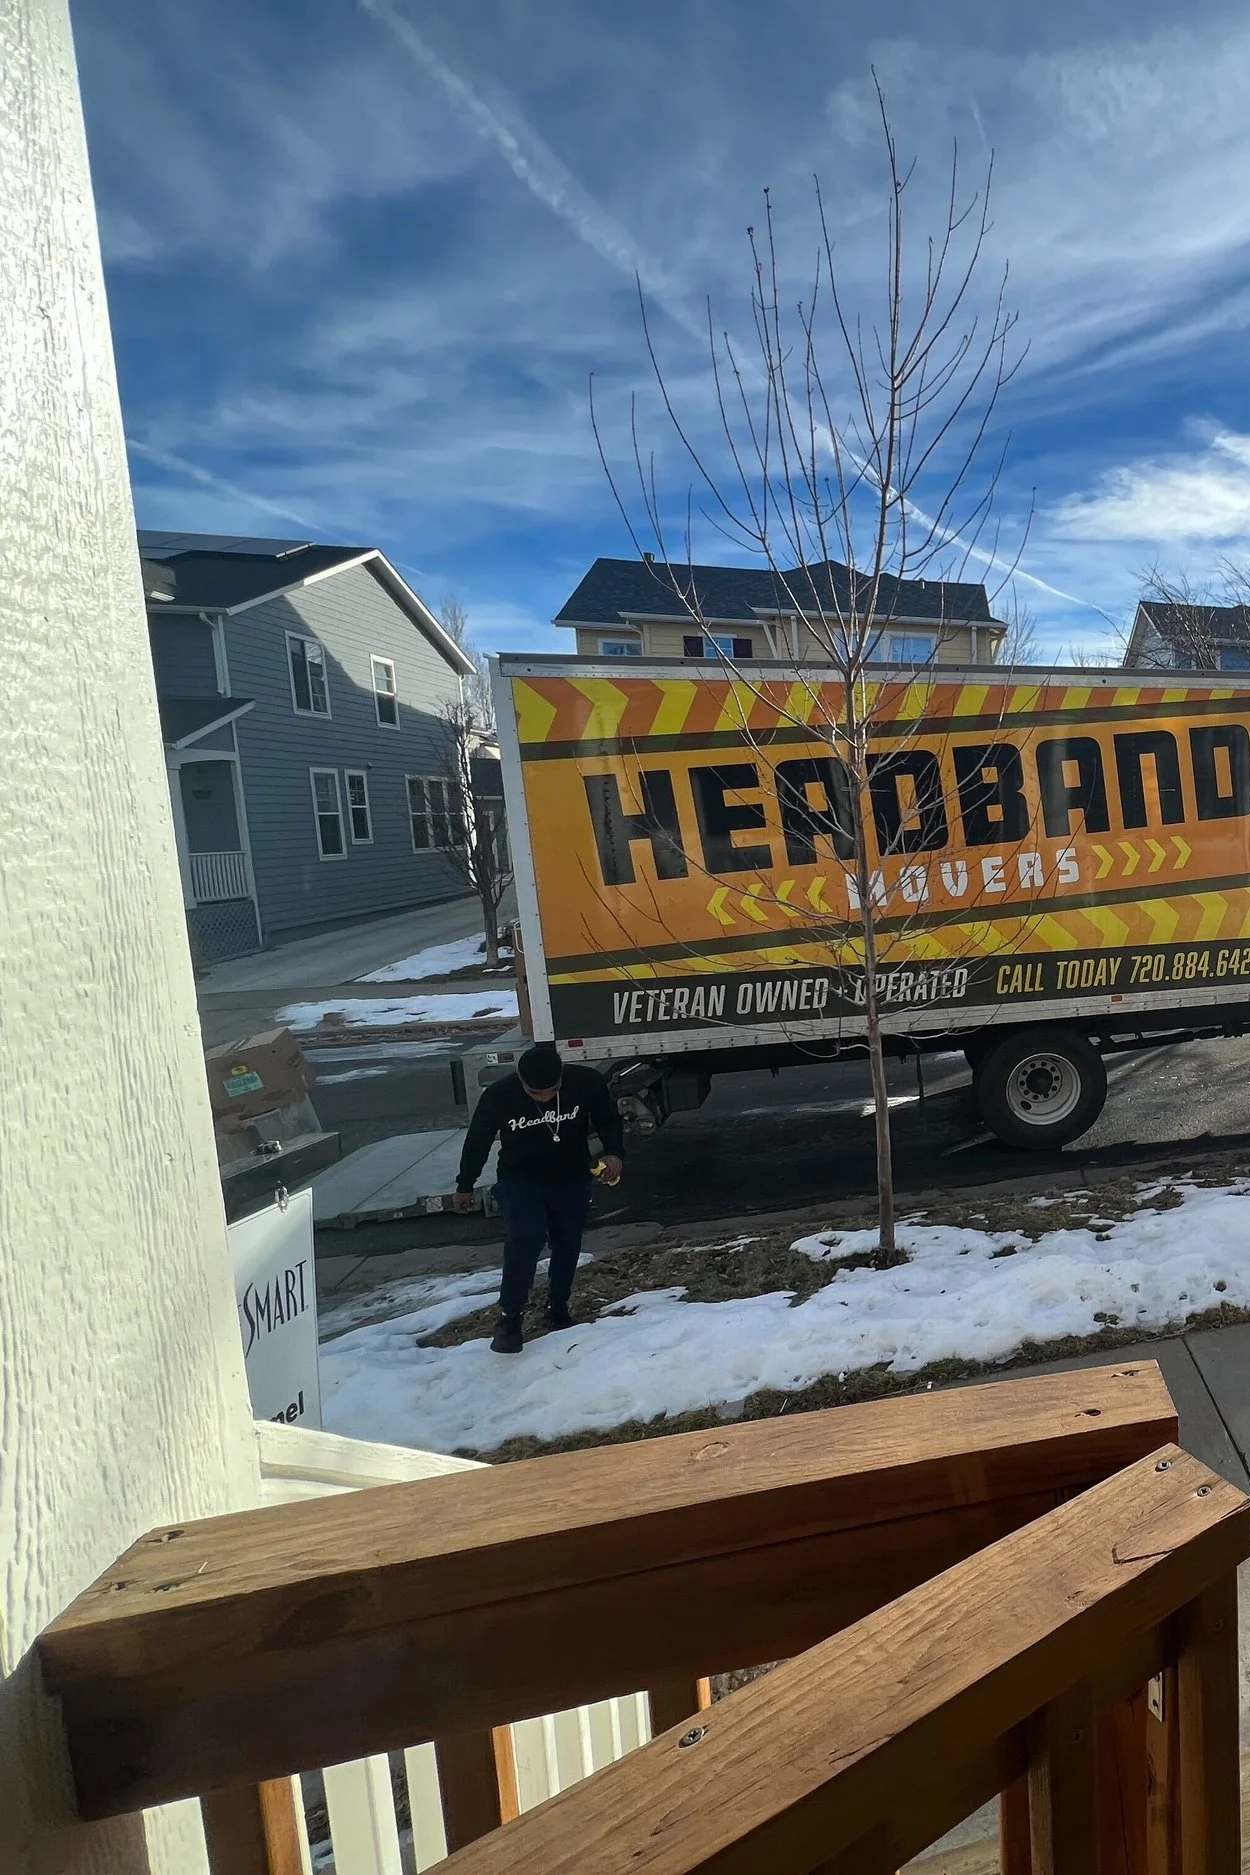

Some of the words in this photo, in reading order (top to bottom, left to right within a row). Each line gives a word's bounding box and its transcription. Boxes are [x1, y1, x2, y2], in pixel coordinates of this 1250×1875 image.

[845, 848, 1080, 909] MOVERS
[613, 985, 725, 1024] VETERAN
[736, 978, 829, 1014] OWNED
[996, 963, 1044, 995] CALL
[1056, 957, 1122, 990] TODAY
[508, 1105, 579, 1131] Headband
[240, 1260, 307, 1358] SMART
